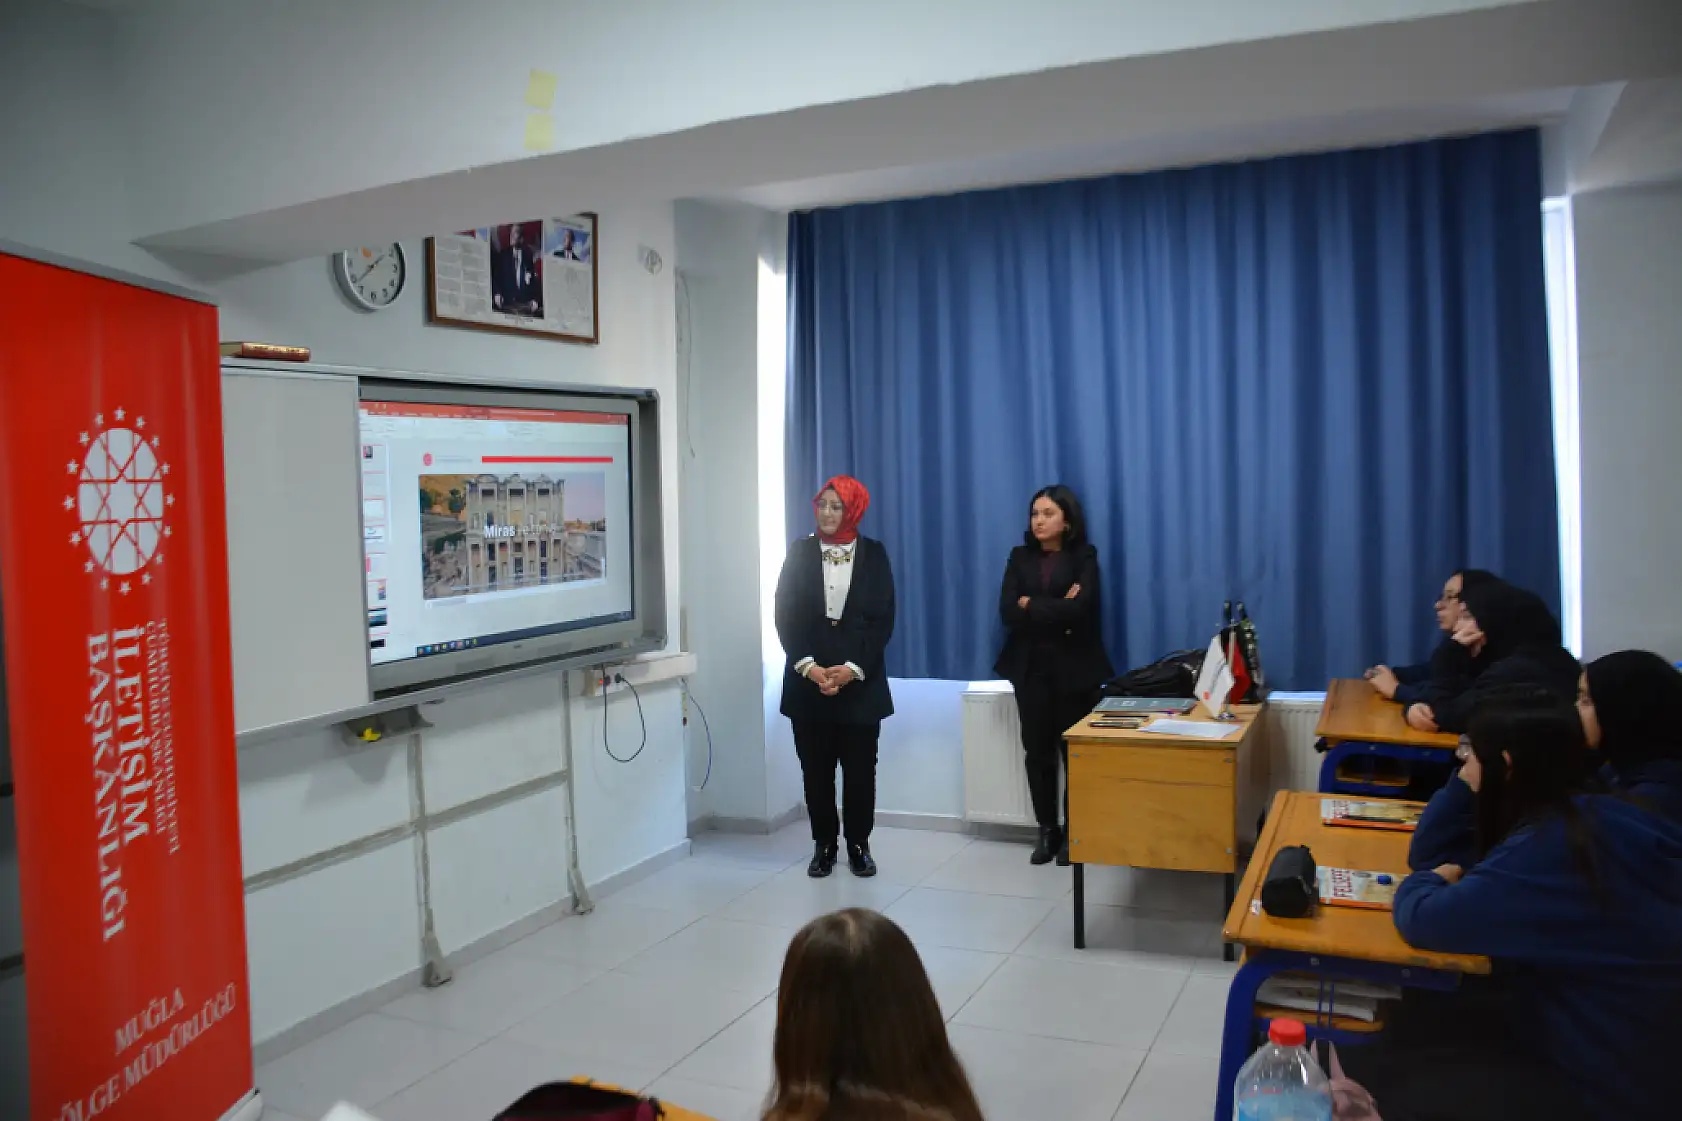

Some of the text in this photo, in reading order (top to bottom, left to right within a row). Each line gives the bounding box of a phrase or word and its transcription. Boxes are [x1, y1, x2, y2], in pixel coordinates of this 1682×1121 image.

[484, 523, 516, 539] Miras
[84, 631, 129, 943] BAŞKANLIĞI
[112, 624, 152, 845] İLETİŞİM
[52, 982, 236, 1121] ÖLGE MÜDÜRLÜĞÜ
[114, 986, 184, 1057] MUĞLA
